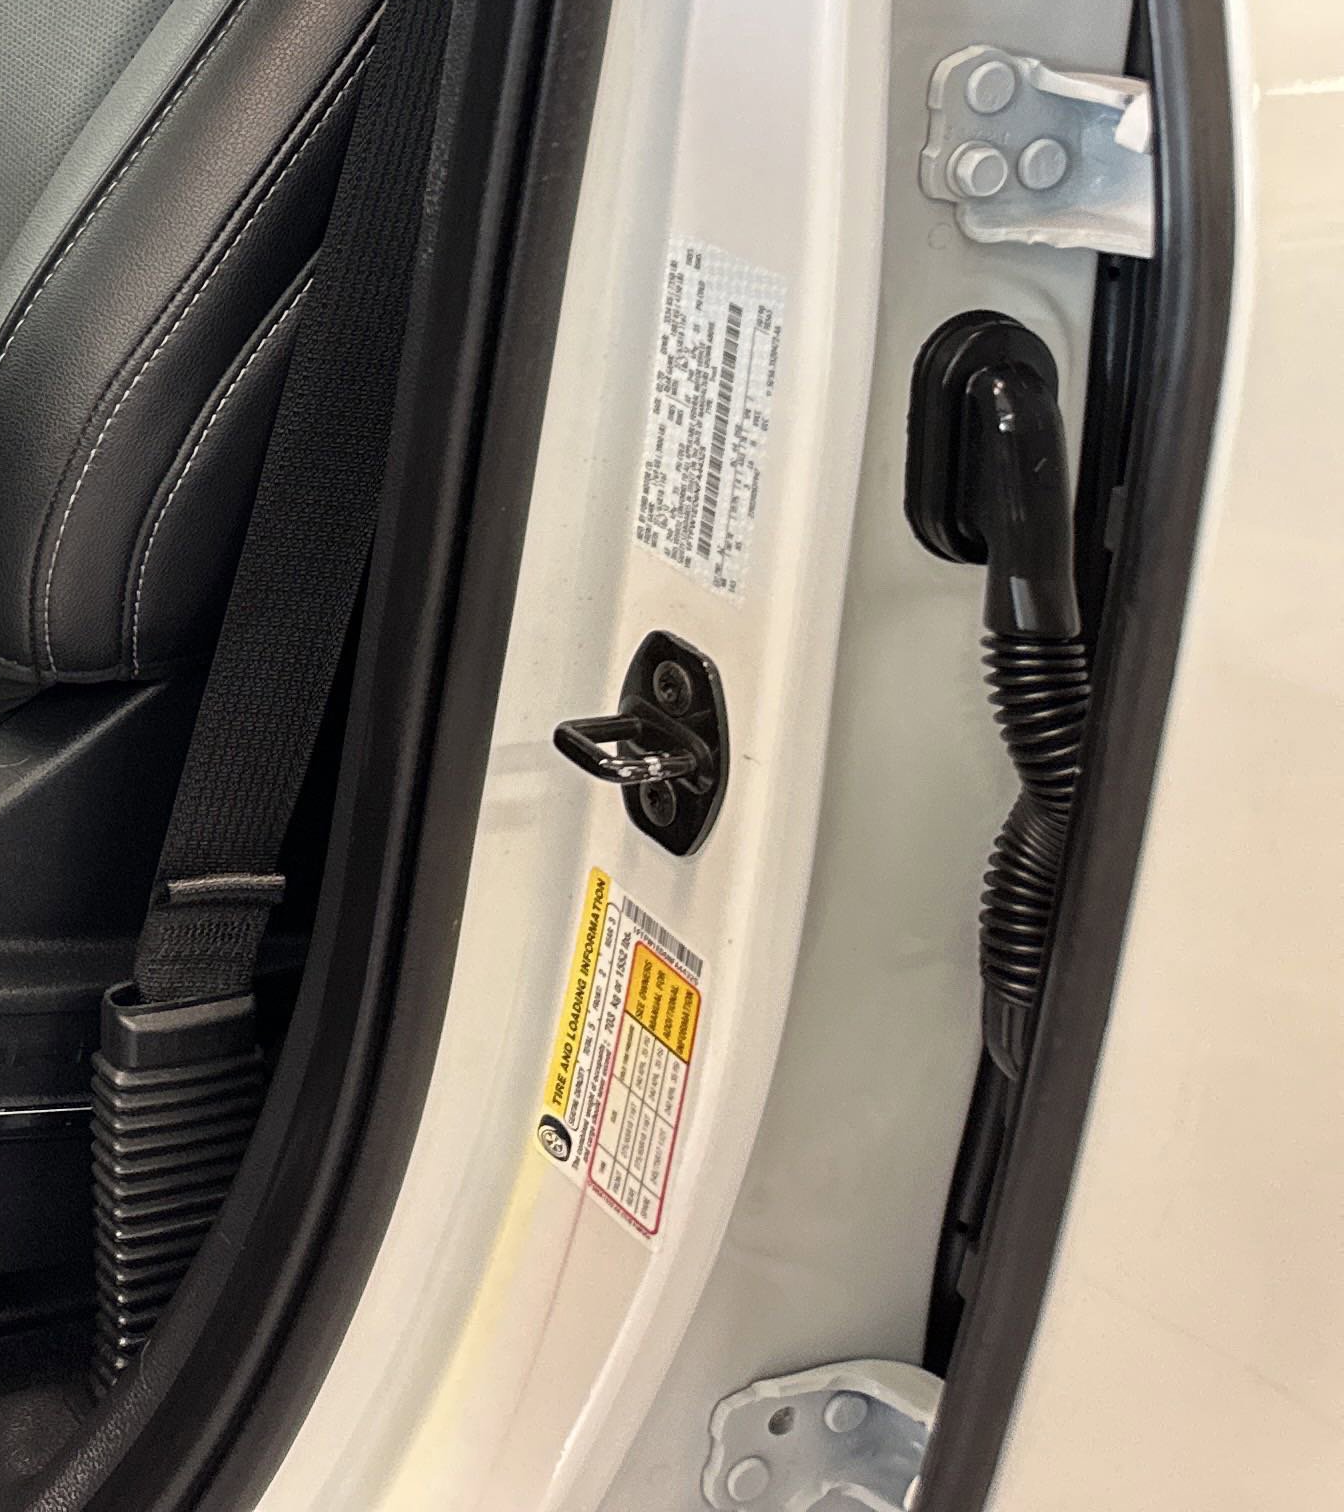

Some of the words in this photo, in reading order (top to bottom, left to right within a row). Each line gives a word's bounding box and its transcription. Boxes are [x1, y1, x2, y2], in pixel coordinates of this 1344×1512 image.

[615, 948, 627, 977] 1552
[551, 1073, 566, 1105] TIRE
[560, 1042, 572, 1072] AND
[566, 978, 586, 1040] LOADING
[580, 878, 605, 975] INFORMATION
[613, 979, 622, 993] or
[648, 993, 662, 1031] MANUAL
[655, 969, 665, 990] FOR
[609, 993, 621, 1009] kg
[635, 1000, 645, 1019] SEE
[662, 985, 679, 1039] ADDITIONAL
[604, 1011, 615, 1033] 703
[676, 990, 693, 1054] INFORMATION
